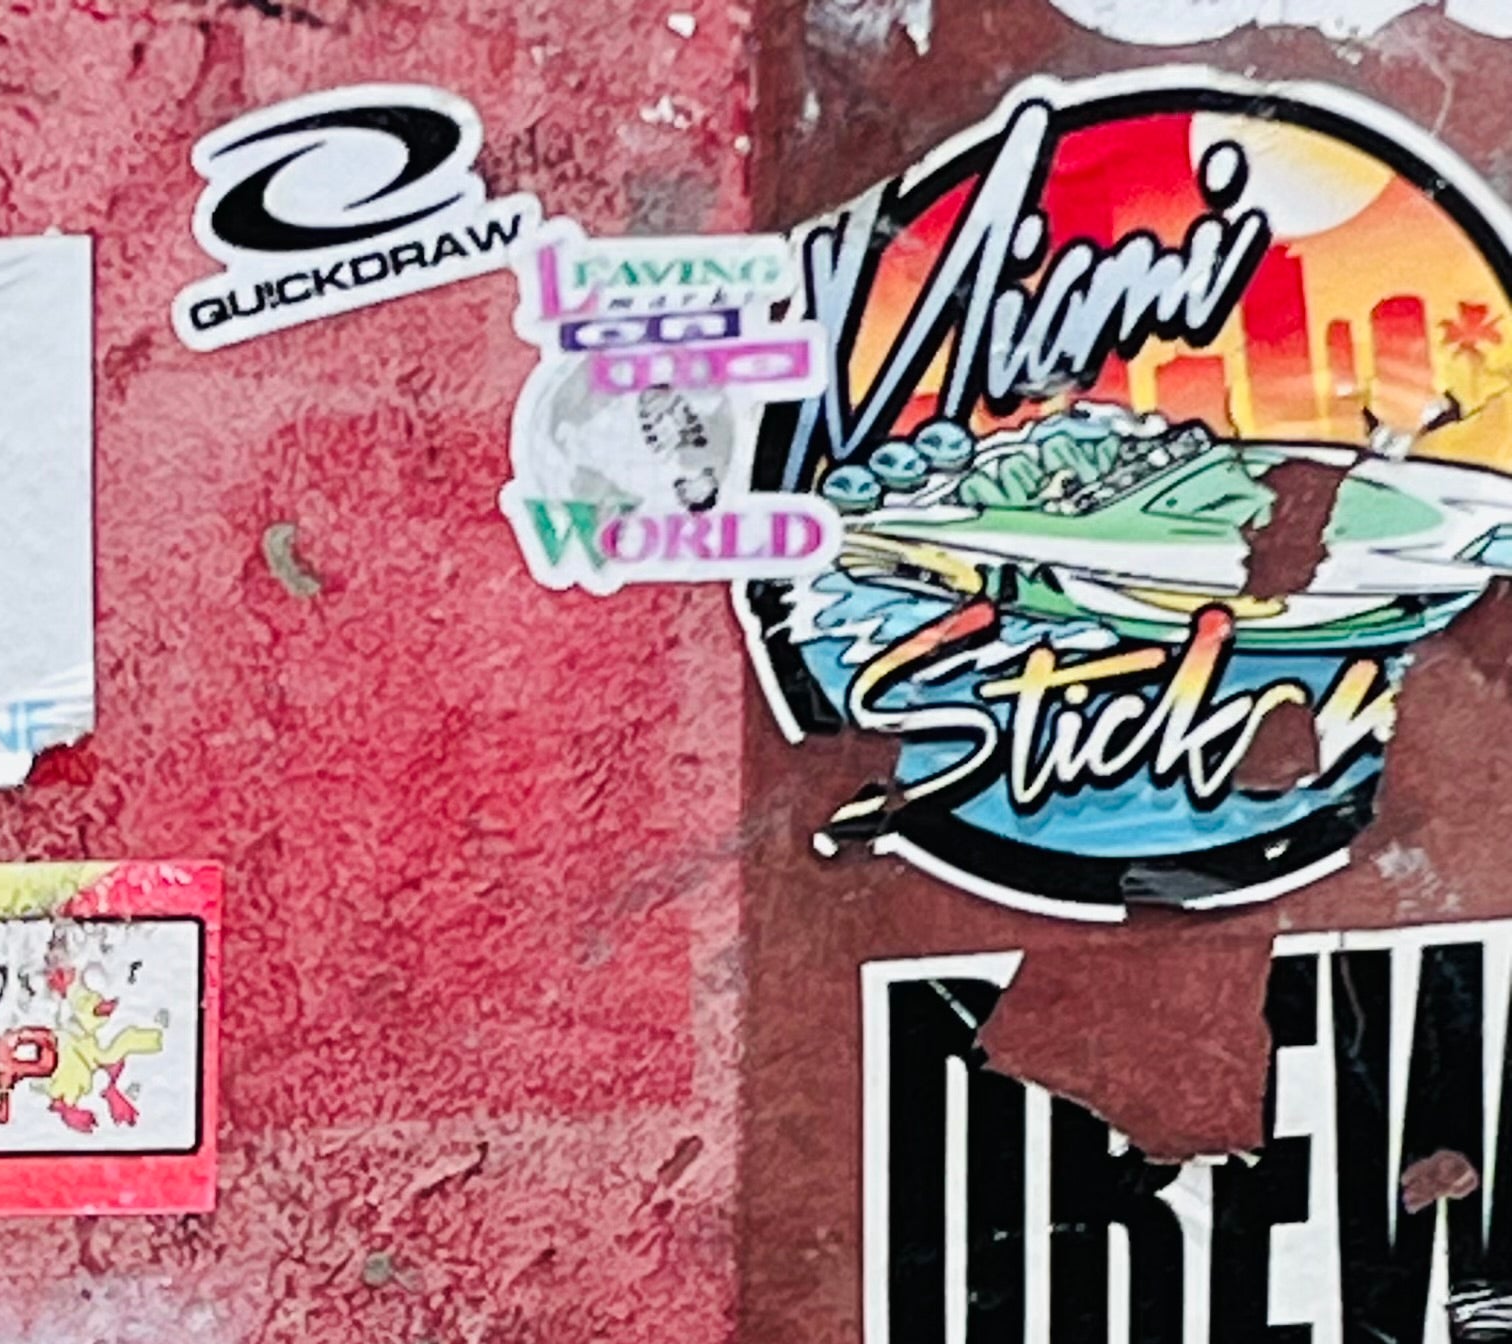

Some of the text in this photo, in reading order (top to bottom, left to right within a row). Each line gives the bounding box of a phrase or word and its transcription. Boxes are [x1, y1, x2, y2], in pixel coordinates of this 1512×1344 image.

[190, 213, 522, 333] QUICKDRAW
[783, 98, 1272, 492] Miami
[523, 498, 824, 571] WORLD
